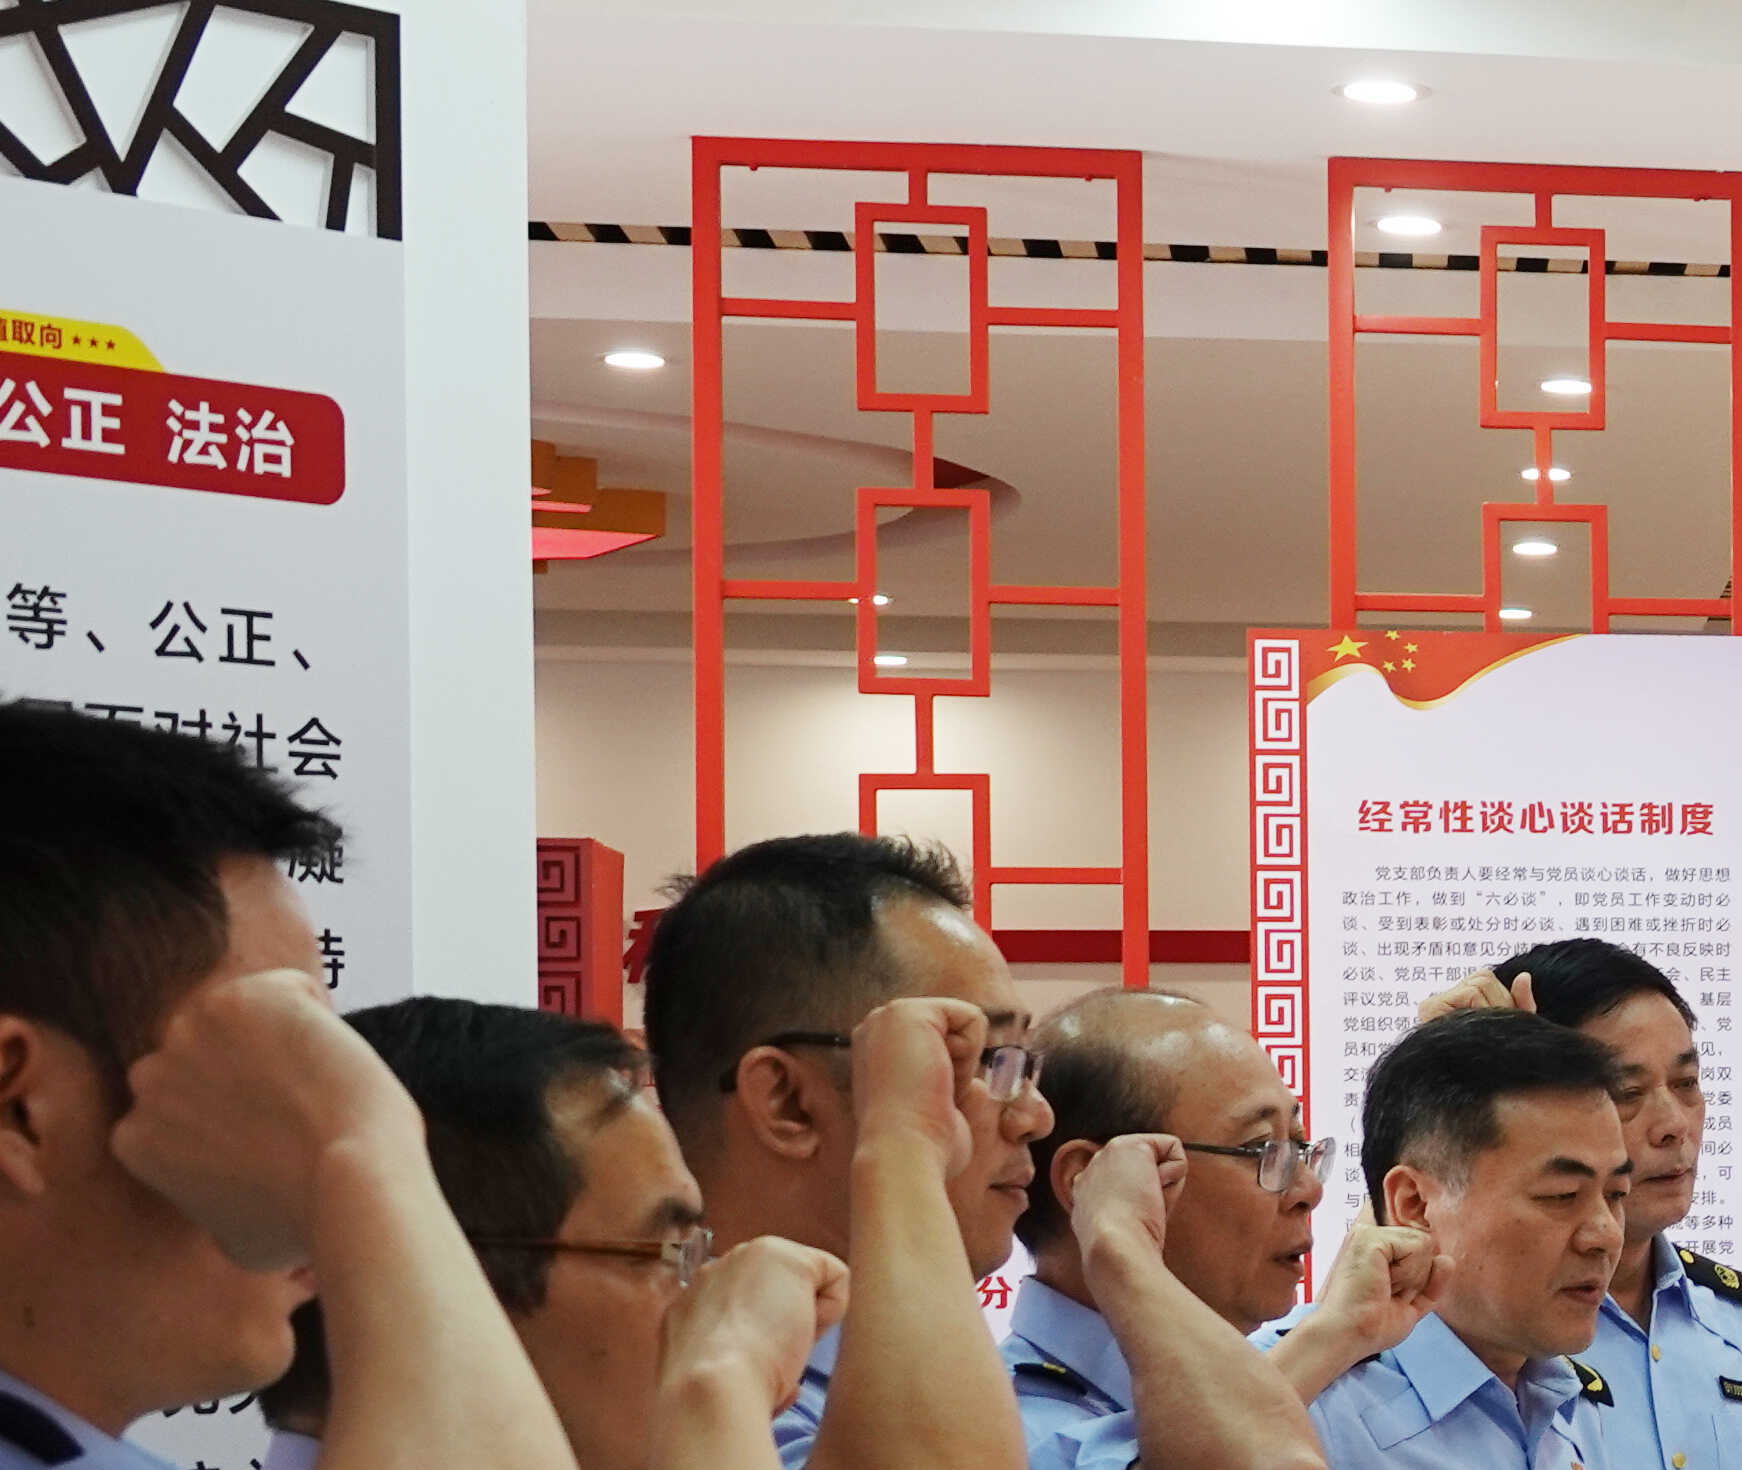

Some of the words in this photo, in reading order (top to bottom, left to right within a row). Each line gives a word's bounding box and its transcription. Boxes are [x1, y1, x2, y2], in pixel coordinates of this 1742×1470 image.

[0, 378, 126, 455] 公正
[166, 399, 295, 478] 法治
[6, 582, 311, 670] 等、公正、
[1357, 799, 1715, 836] 经常性谈心谈话制度
[1375, 865, 1732, 883] 党支部负责人要经常与党员谈心谈话，做好思想
[1342, 941, 1540, 957] 谈、出现矛盾和意见分歧
[1620, 942, 1731, 957] 有不良反映时
[1700, 991, 1732, 1007] 基层
[1345, 1142, 1360, 1157] 相
[1345, 1167, 1360, 1182] 谈
